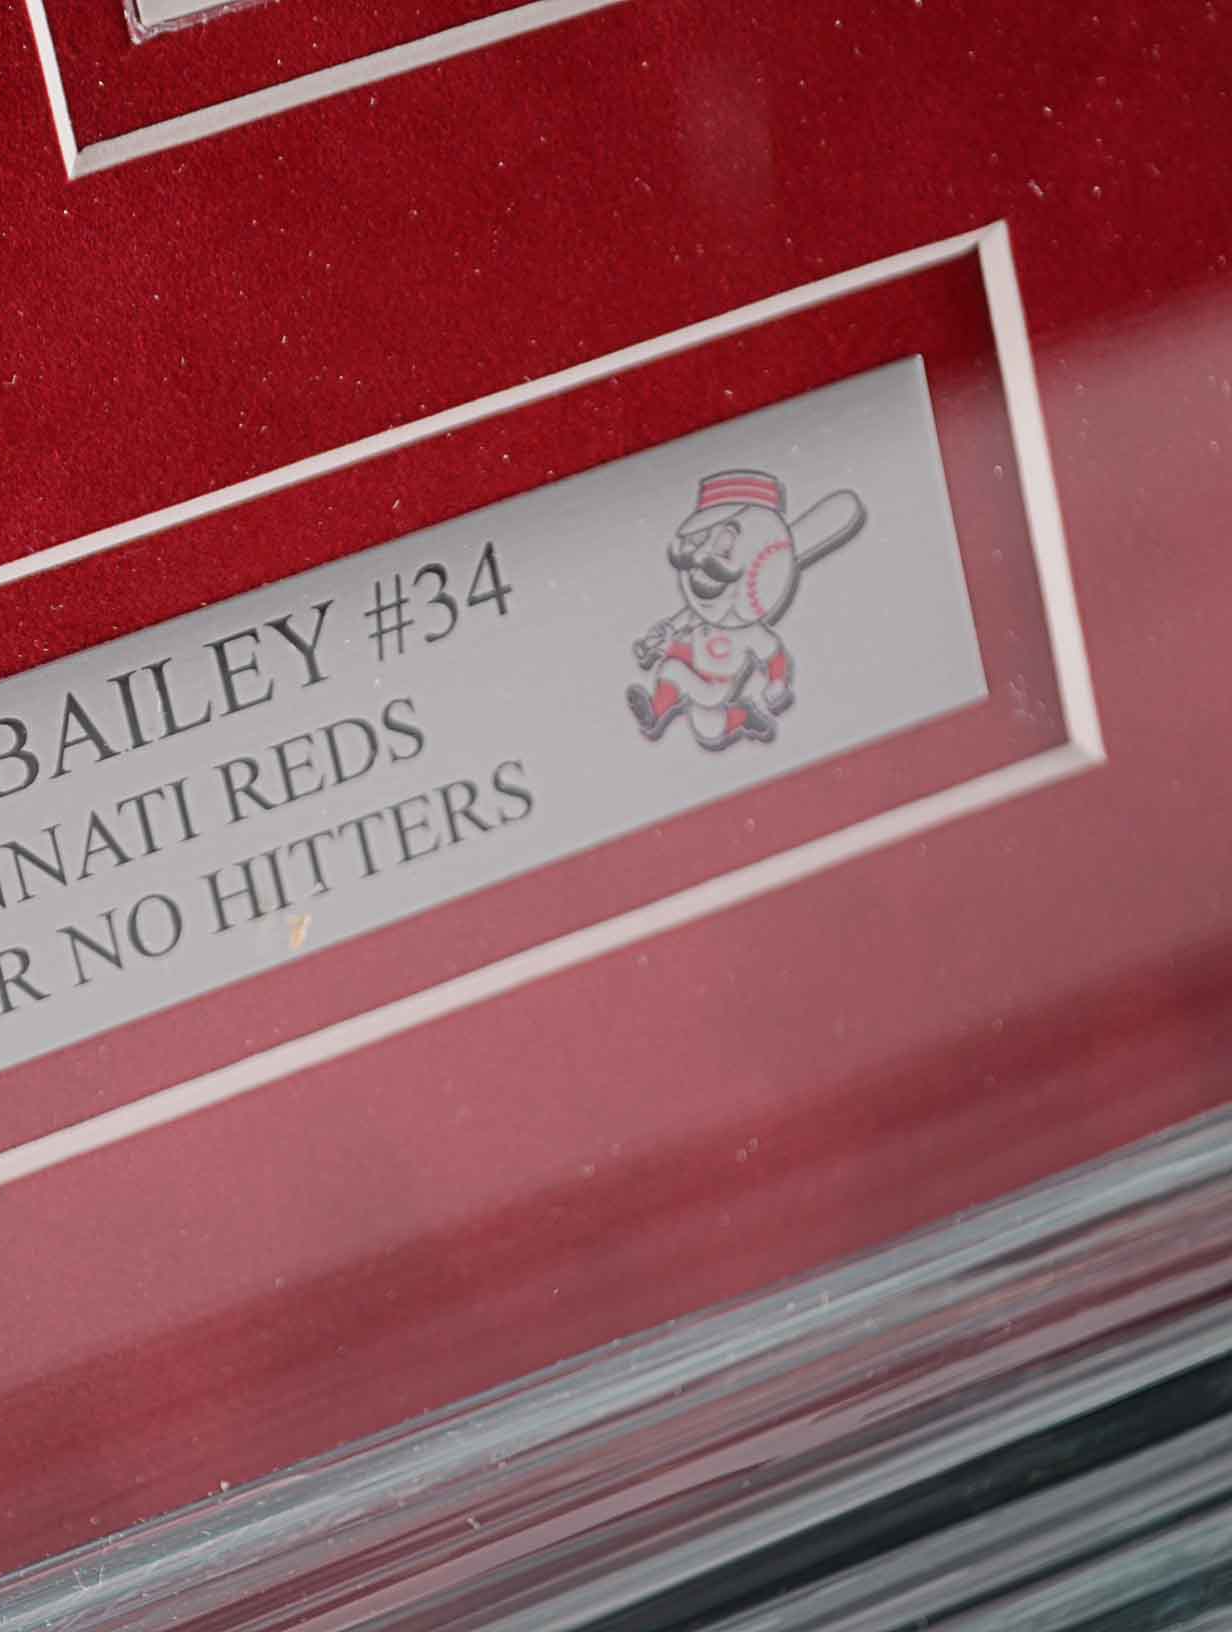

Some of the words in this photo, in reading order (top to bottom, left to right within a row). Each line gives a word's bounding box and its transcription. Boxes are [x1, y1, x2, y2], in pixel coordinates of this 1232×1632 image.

[364, 541, 513, 662] #34
[214, 697, 425, 825] REDS
[55, 893, 184, 987] NO
[201, 760, 536, 934] HITTERS
